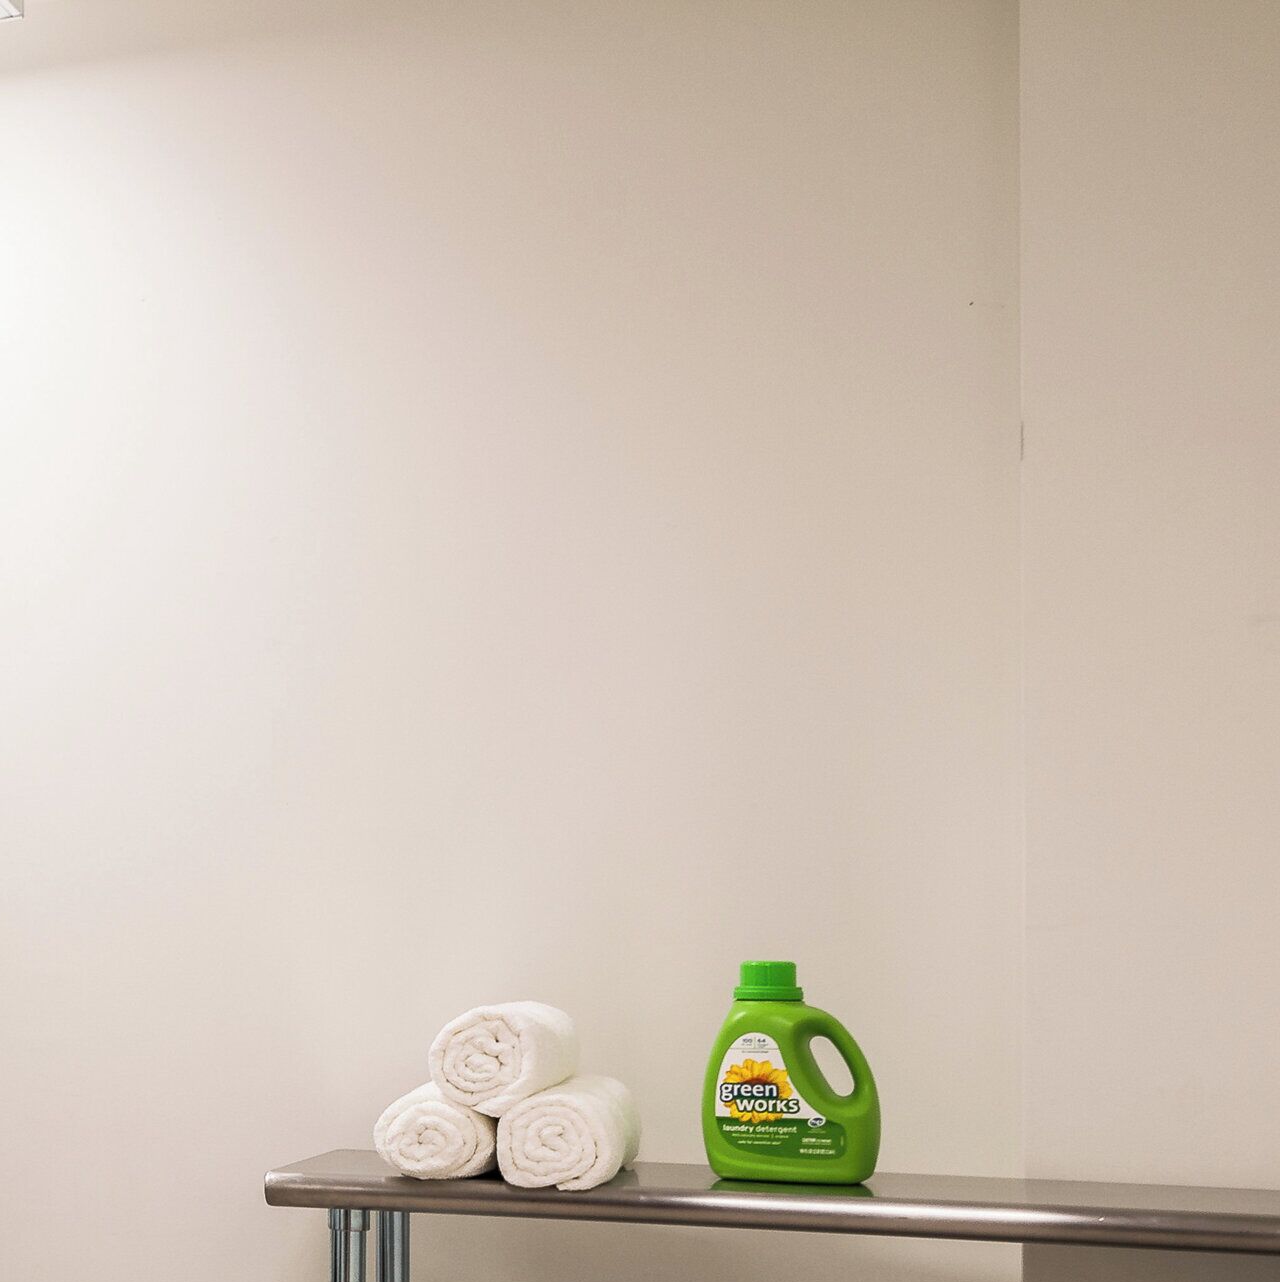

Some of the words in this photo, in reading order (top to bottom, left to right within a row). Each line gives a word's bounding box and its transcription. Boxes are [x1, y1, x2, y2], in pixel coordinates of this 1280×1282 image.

[720, 1083, 778, 1102] green
[736, 1099, 799, 1114] works
[722, 1124, 753, 1133] laundry
[755, 1125, 797, 1134] detergent
